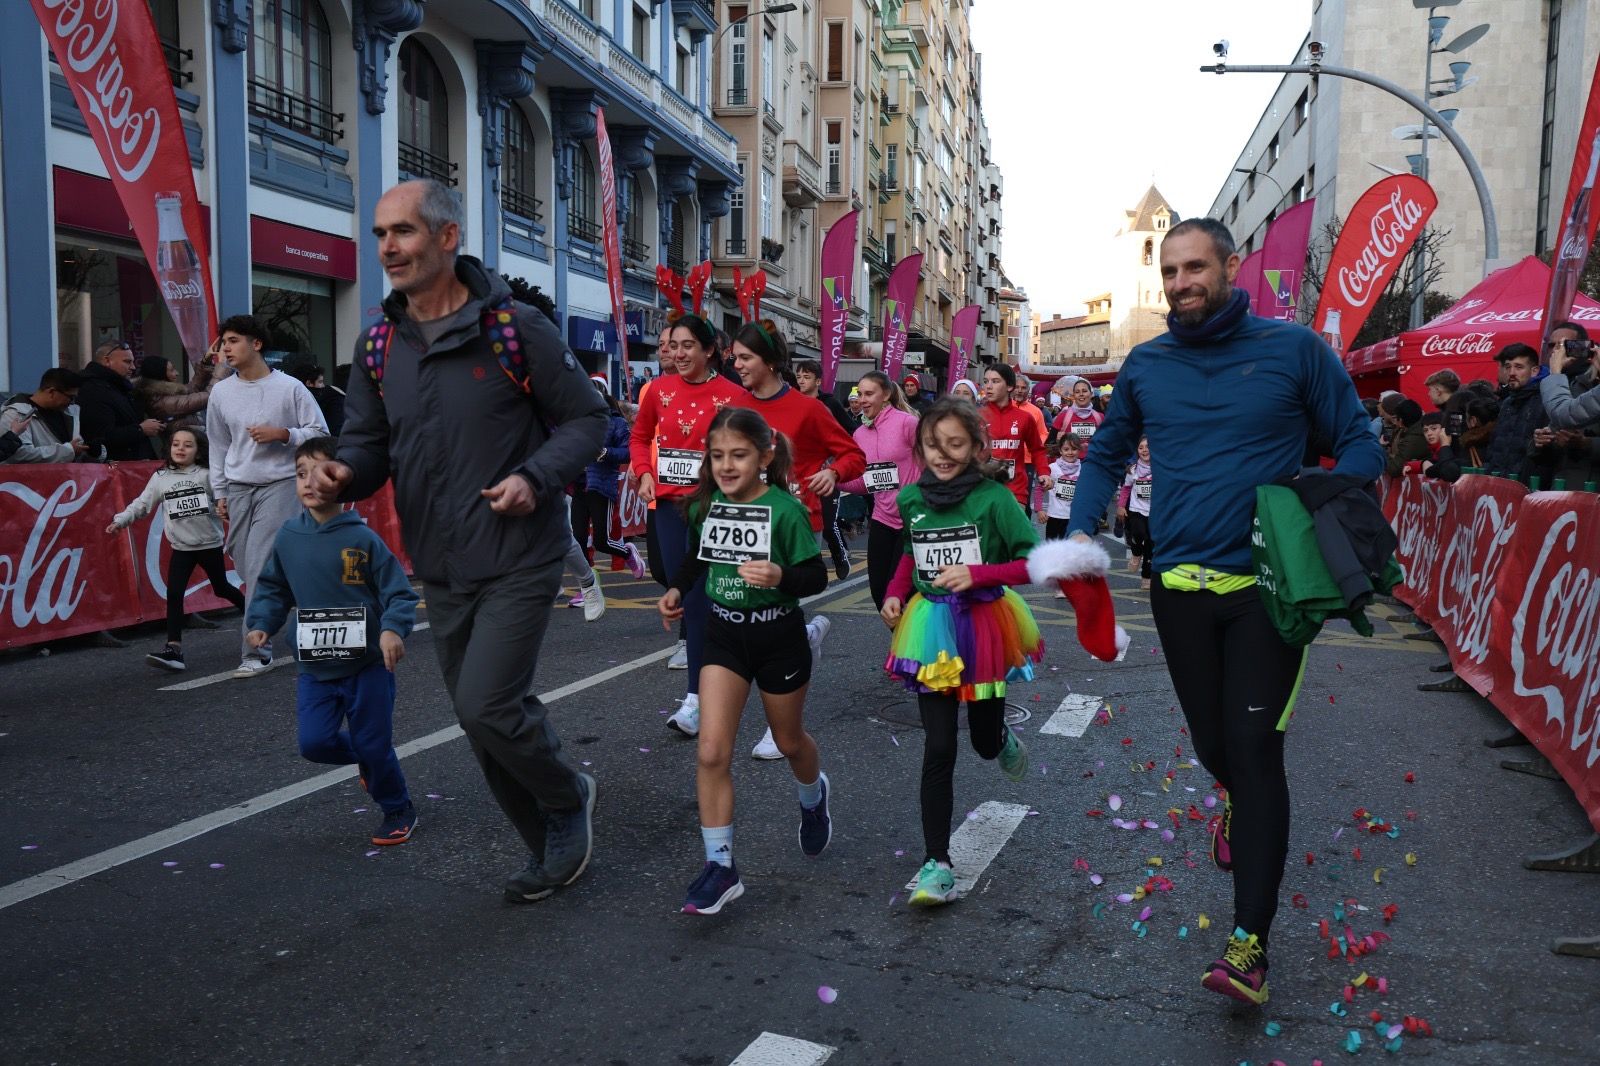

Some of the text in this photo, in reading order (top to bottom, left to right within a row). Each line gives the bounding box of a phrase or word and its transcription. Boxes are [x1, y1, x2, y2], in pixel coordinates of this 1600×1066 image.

[285, 244, 329, 262] banca cooperativa
[1338, 184, 1423, 307] Coca-Cola
[1464, 303, 1600, 325] Coca-Cla
[590, 329, 606, 352] AXA
[1421, 332, 1496, 357] Coca-Cola
[667, 462, 692, 476] 4002
[872, 472, 893, 484] 9000
[176, 498, 201, 511] 4630
[708, 525, 758, 548] 4780
[925, 547, 964, 567] 4782
[724, 587, 745, 600] eón
[712, 603, 745, 623] PRO
[311, 626, 347, 646] 7777
